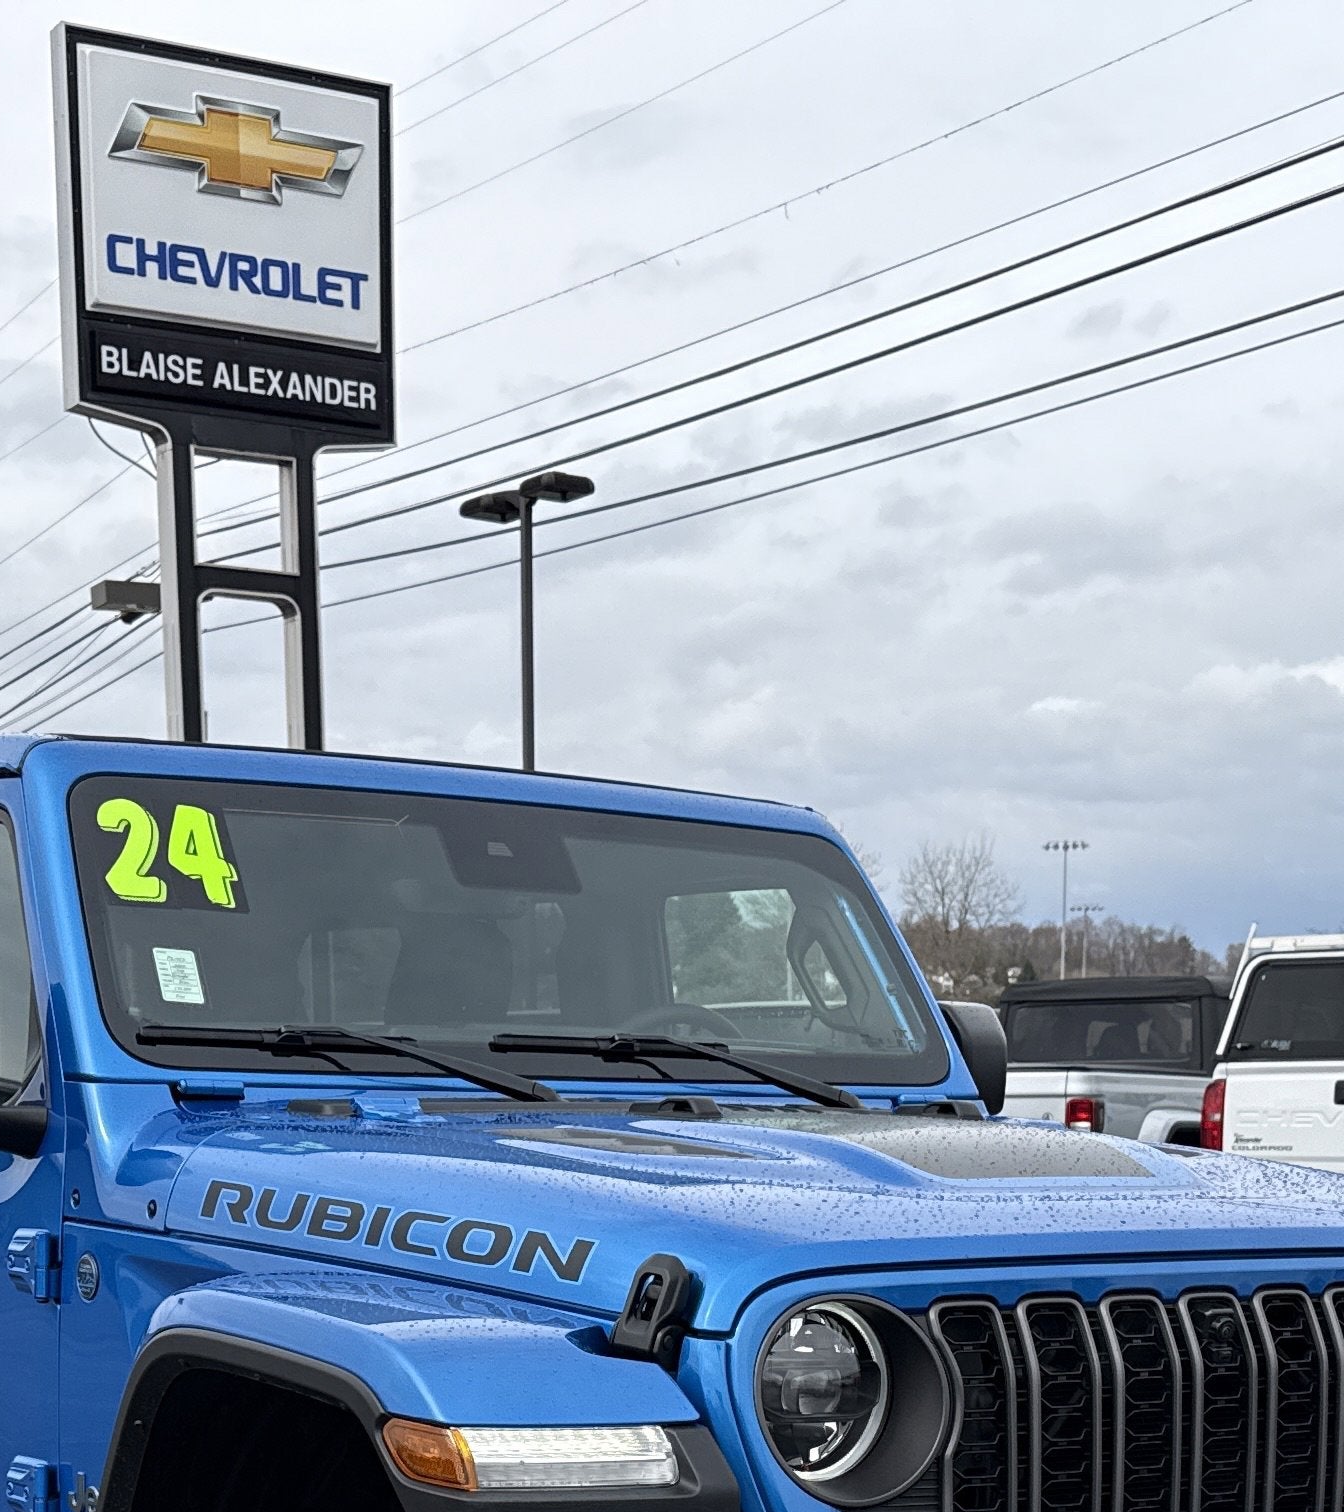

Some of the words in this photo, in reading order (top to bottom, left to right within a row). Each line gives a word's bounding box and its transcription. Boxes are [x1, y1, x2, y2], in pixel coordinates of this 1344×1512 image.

[106, 233, 369, 311] CHEVROLET
[100, 344, 204, 387] BLAISE
[212, 361, 377, 411] ALEXANDER
[96, 798, 238, 909] 24
[199, 1177, 599, 1285] RUBICON
